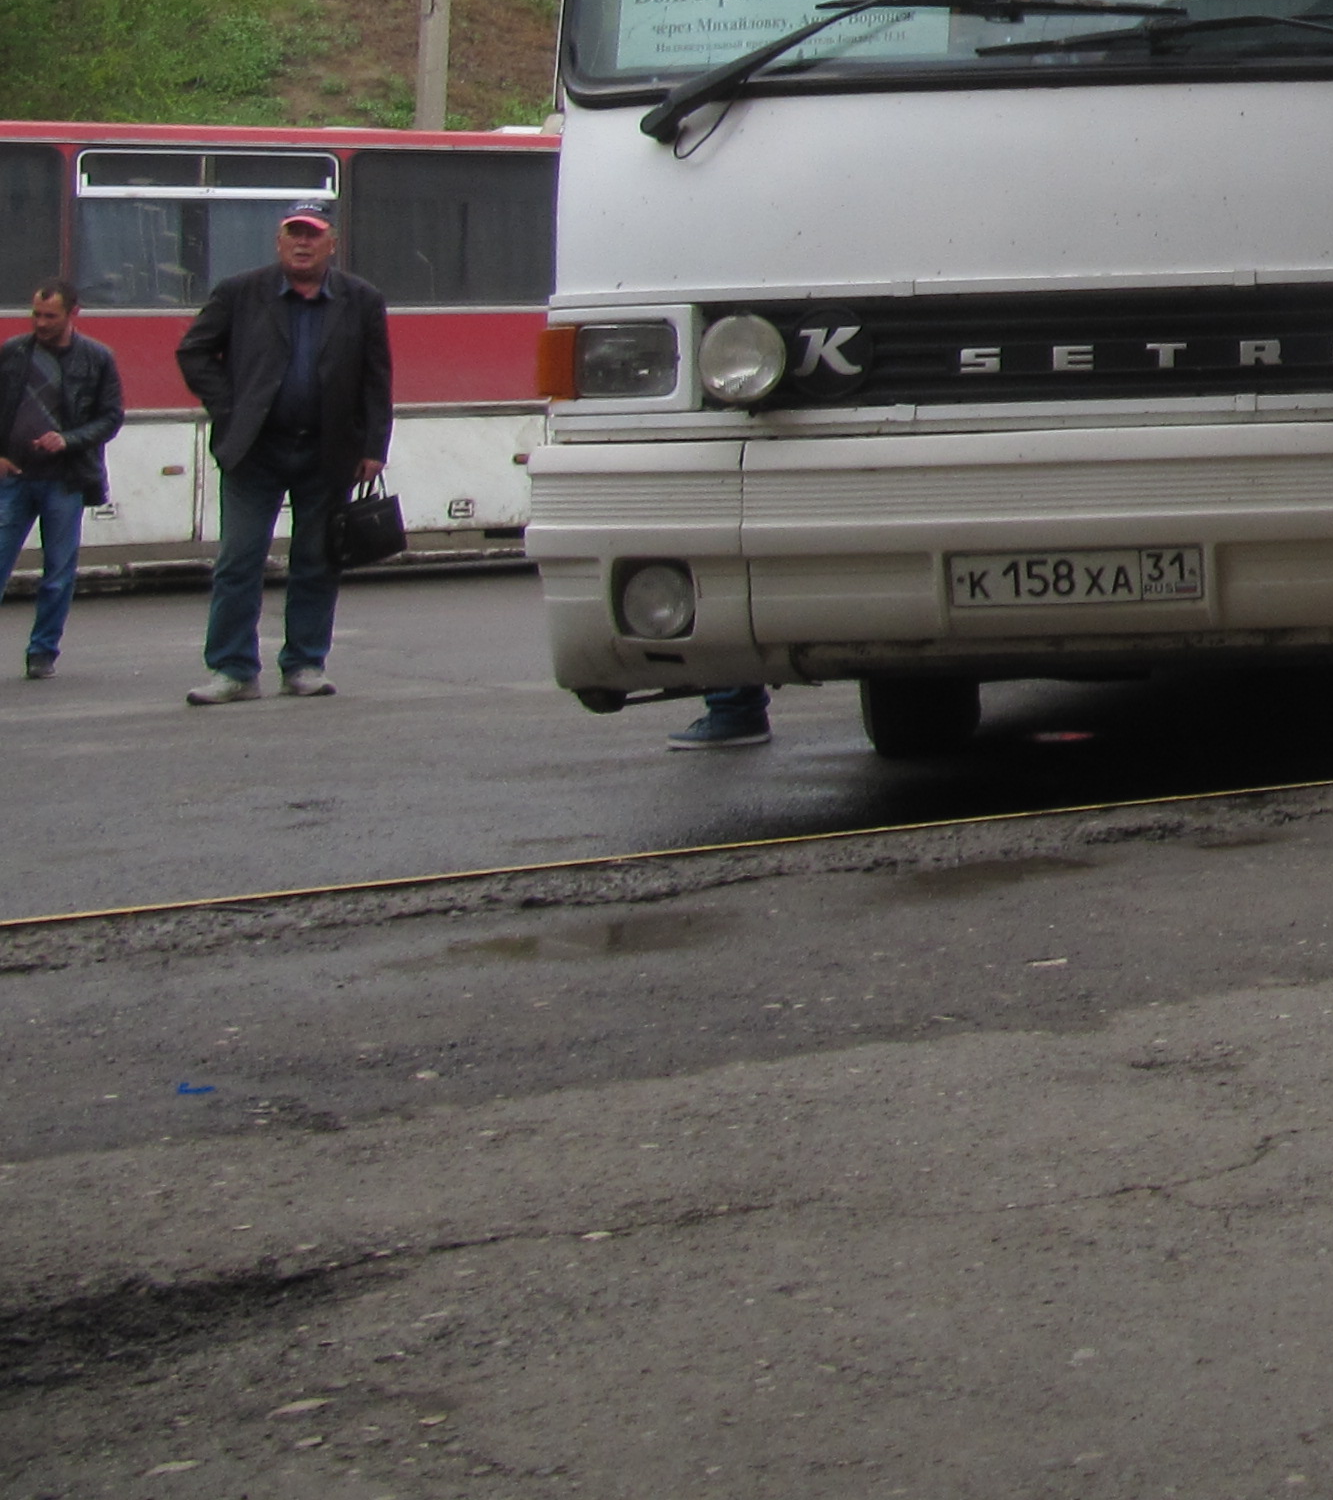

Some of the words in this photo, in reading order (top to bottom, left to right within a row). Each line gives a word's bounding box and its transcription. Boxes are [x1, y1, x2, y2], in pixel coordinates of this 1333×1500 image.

[652, 22, 692, 37] через
[794, 324, 862, 377] K
[1146, 552, 1185, 581] 31
[1144, 582, 1173, 594] RUS
